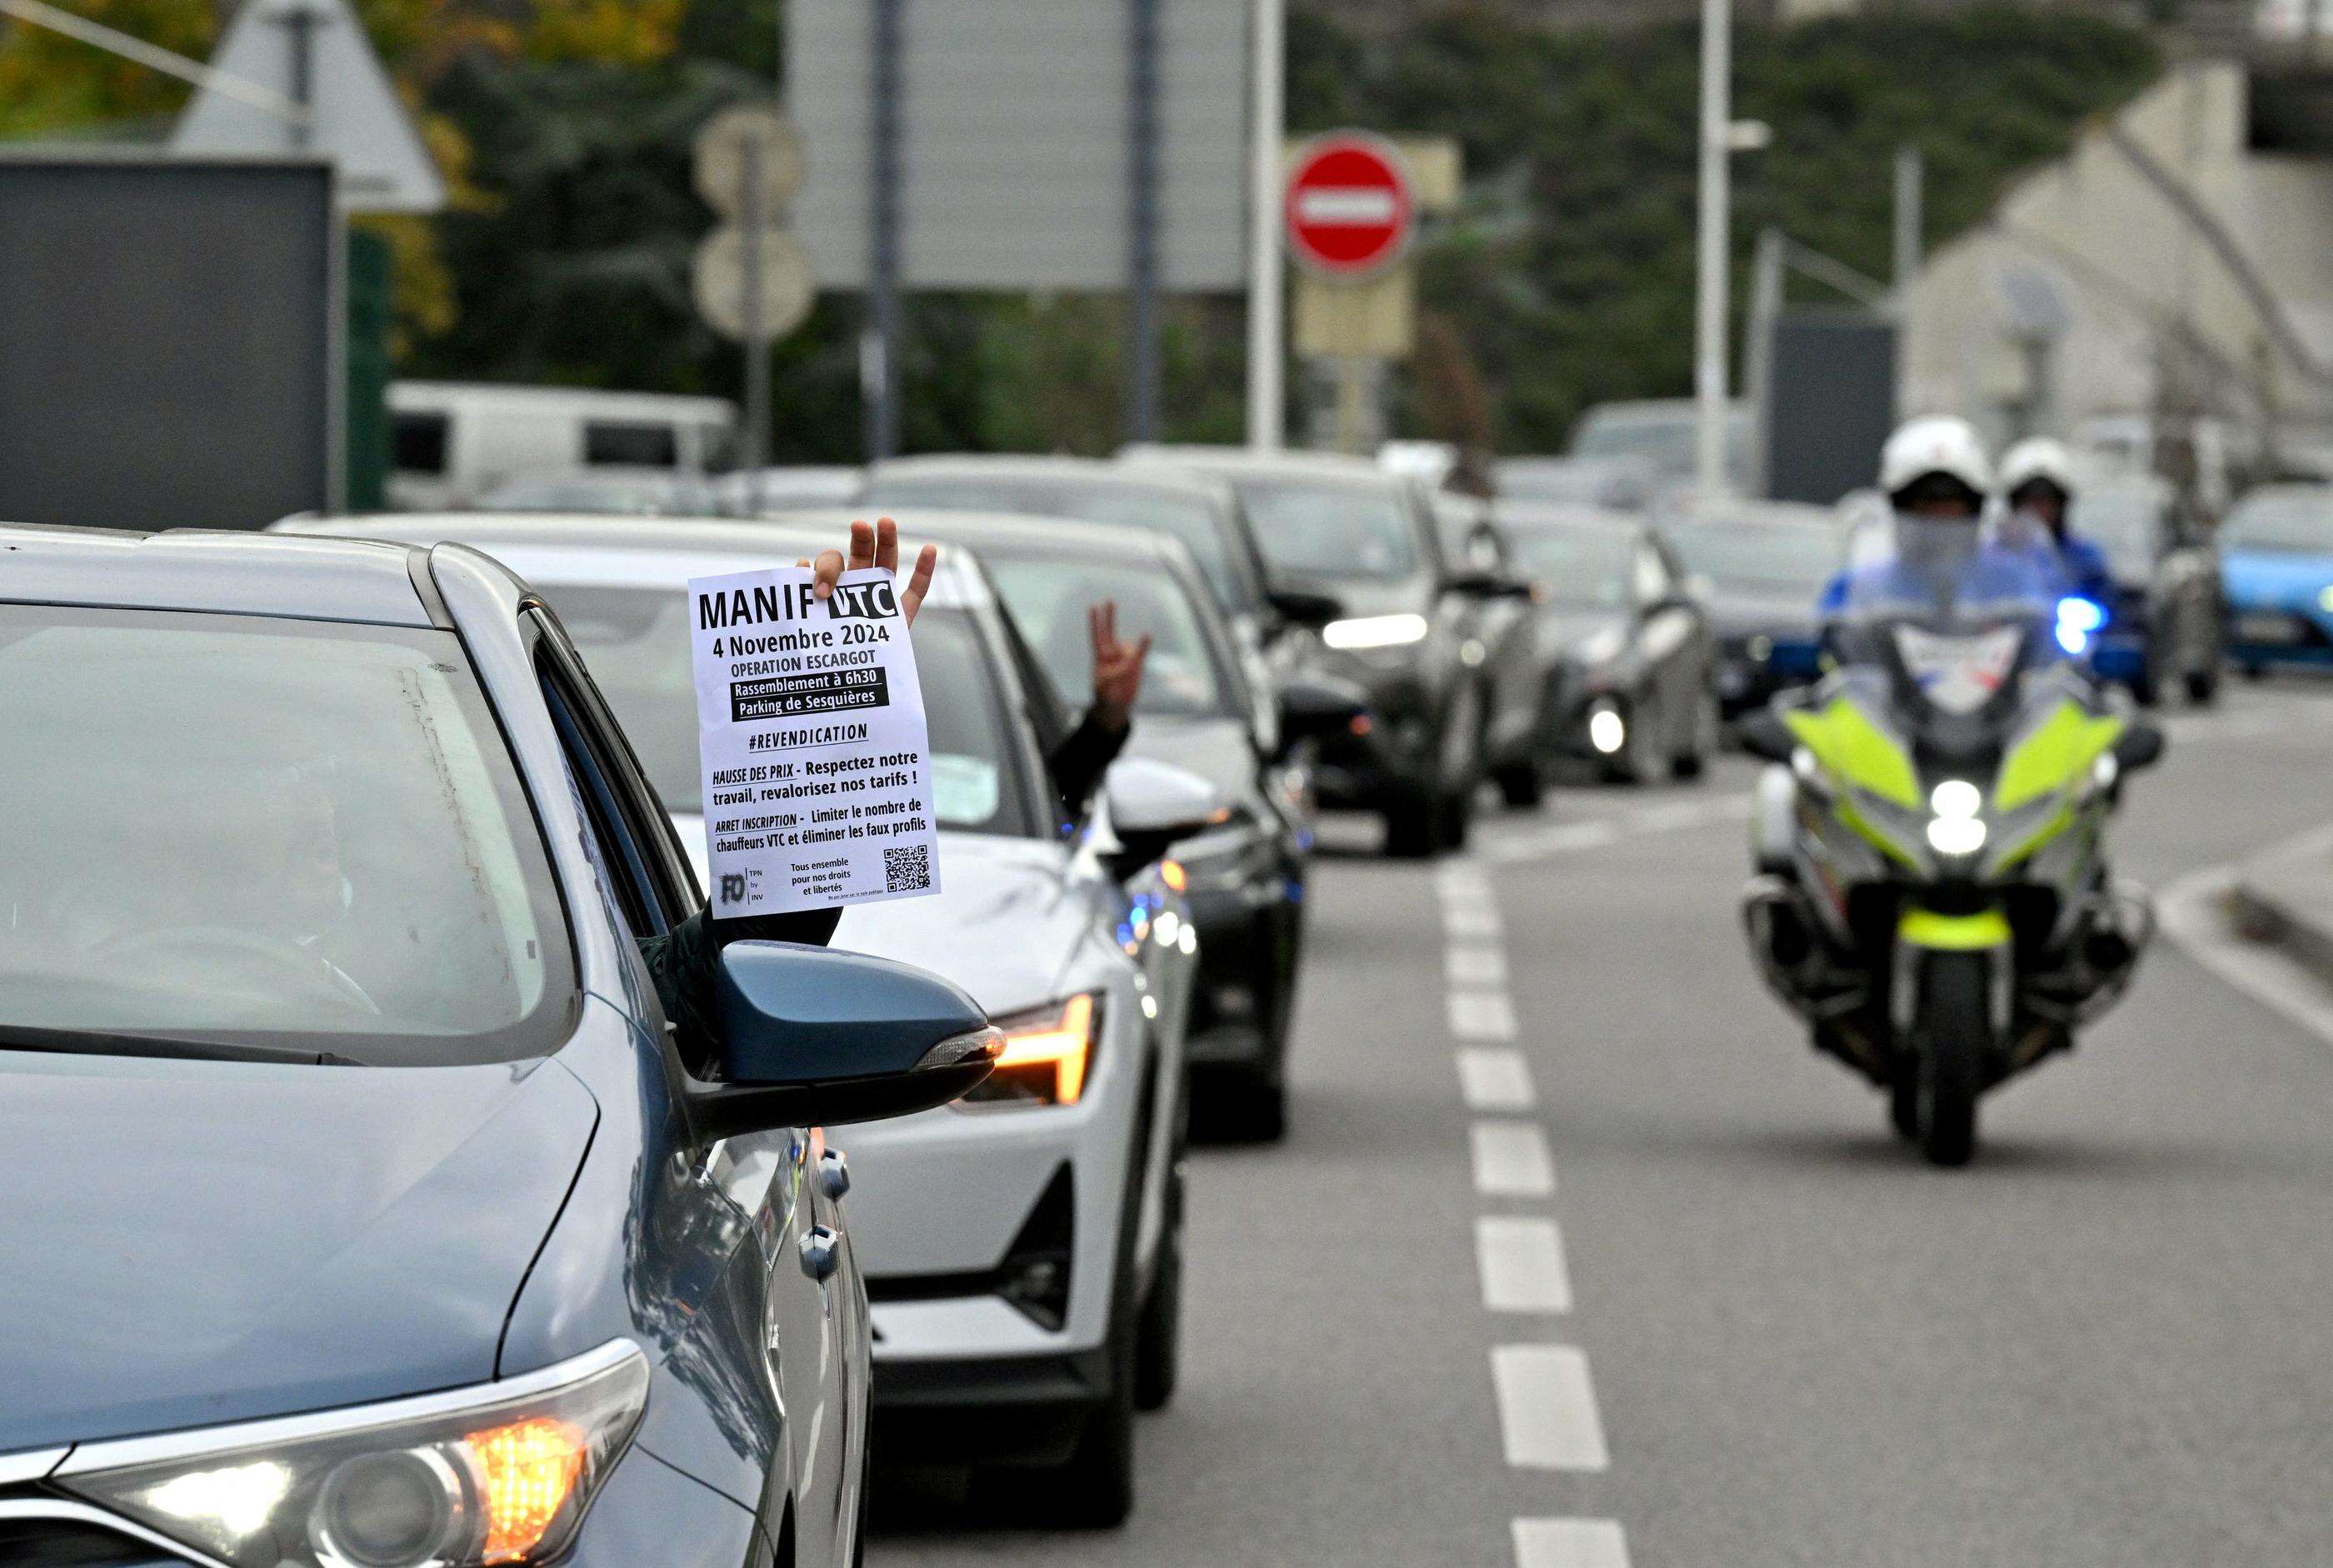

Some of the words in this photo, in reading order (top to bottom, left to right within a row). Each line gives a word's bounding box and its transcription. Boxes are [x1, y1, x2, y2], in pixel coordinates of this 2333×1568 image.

[699, 584, 813, 630] MANIF
[832, 582, 896, 617] VTC
[713, 637, 723, 658] 4
[730, 628, 832, 657] Novembre
[841, 624, 889, 645] 2024
[732, 657, 801, 677] OPERATION
[807, 649, 875, 669] ESCARGOT
[736, 674, 829, 697] Rassemblement
[834, 673, 841, 687] à
[846, 670, 877, 684] 6h30
[740, 700, 782, 716] Parking
[787, 697, 801, 710] de
[806, 691, 875, 710] Sesquières
[750, 724, 867, 750] #REVENDICATION
[713, 768, 747, 785] HAUSSE
[750, 767, 767, 782] DES
[770, 763, 793, 778] PRIX
[806, 757, 874, 776] Respectez
[880, 752, 917, 767] notre
[713, 789, 757, 805] travail,
[762, 780, 836, 801] revalorisez
[841, 778, 865, 791] nos
[870, 772, 907, 788] tarifs
[912, 771, 917, 784] !
[716, 817, 739, 832] ARRET
[742, 814, 797, 831] INSCRIPTION
[812, 806, 847, 823] Limiter
[852, 805, 861, 819] le
[865, 801, 905, 816] nombre
[909, 798, 921, 811] de
[717, 834, 764, 852] chauffeurs
[767, 833, 785, 847] VTC
[788, 833, 799, 845] et
[802, 826, 844, 844] éliminer
[849, 824, 862, 839] les
[867, 822, 889, 836] faux
[892, 817, 926, 834] profils
[792, 863, 810, 872] Tous
[812, 857, 848, 871] ensemble
[792, 876, 810, 886] pour
[812, 874, 826, 882] nos
[829, 870, 850, 881] droits
[803, 887, 812, 896] et
[813, 883, 842, 895] libertés
